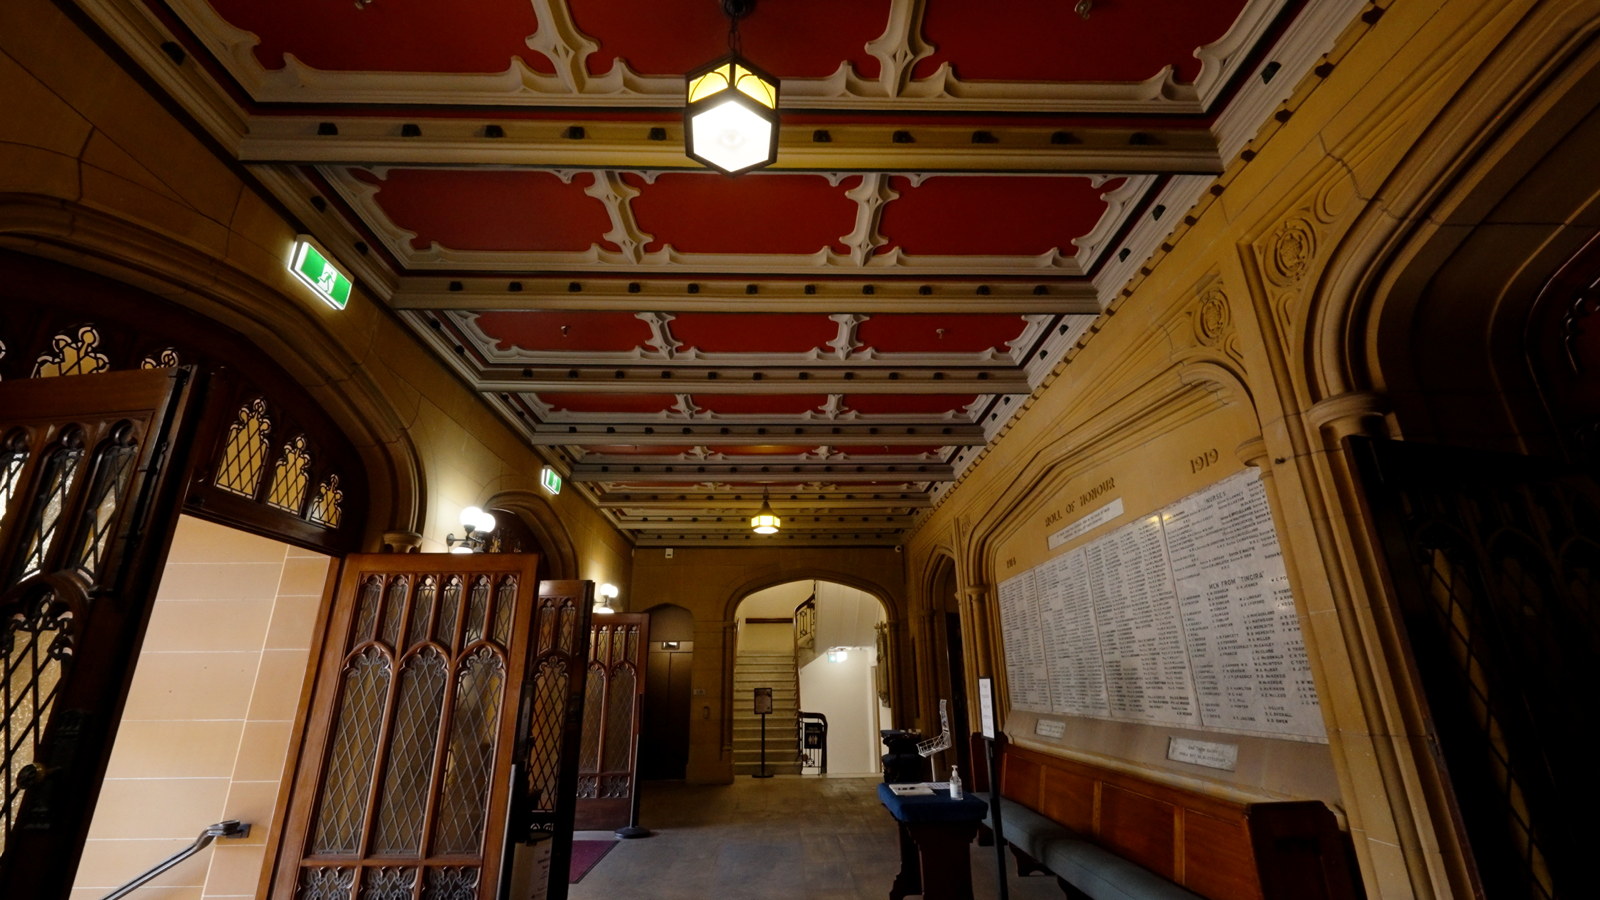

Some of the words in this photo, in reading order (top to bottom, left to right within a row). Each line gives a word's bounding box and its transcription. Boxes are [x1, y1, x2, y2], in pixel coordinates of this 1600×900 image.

[1189, 448, 1219, 474] 1919
[1045, 510, 1063, 527] ROLL
[1065, 500, 1076, 513] OF
[1079, 477, 1115, 507] HONOUR
[1221, 578, 1236, 587] FROM
